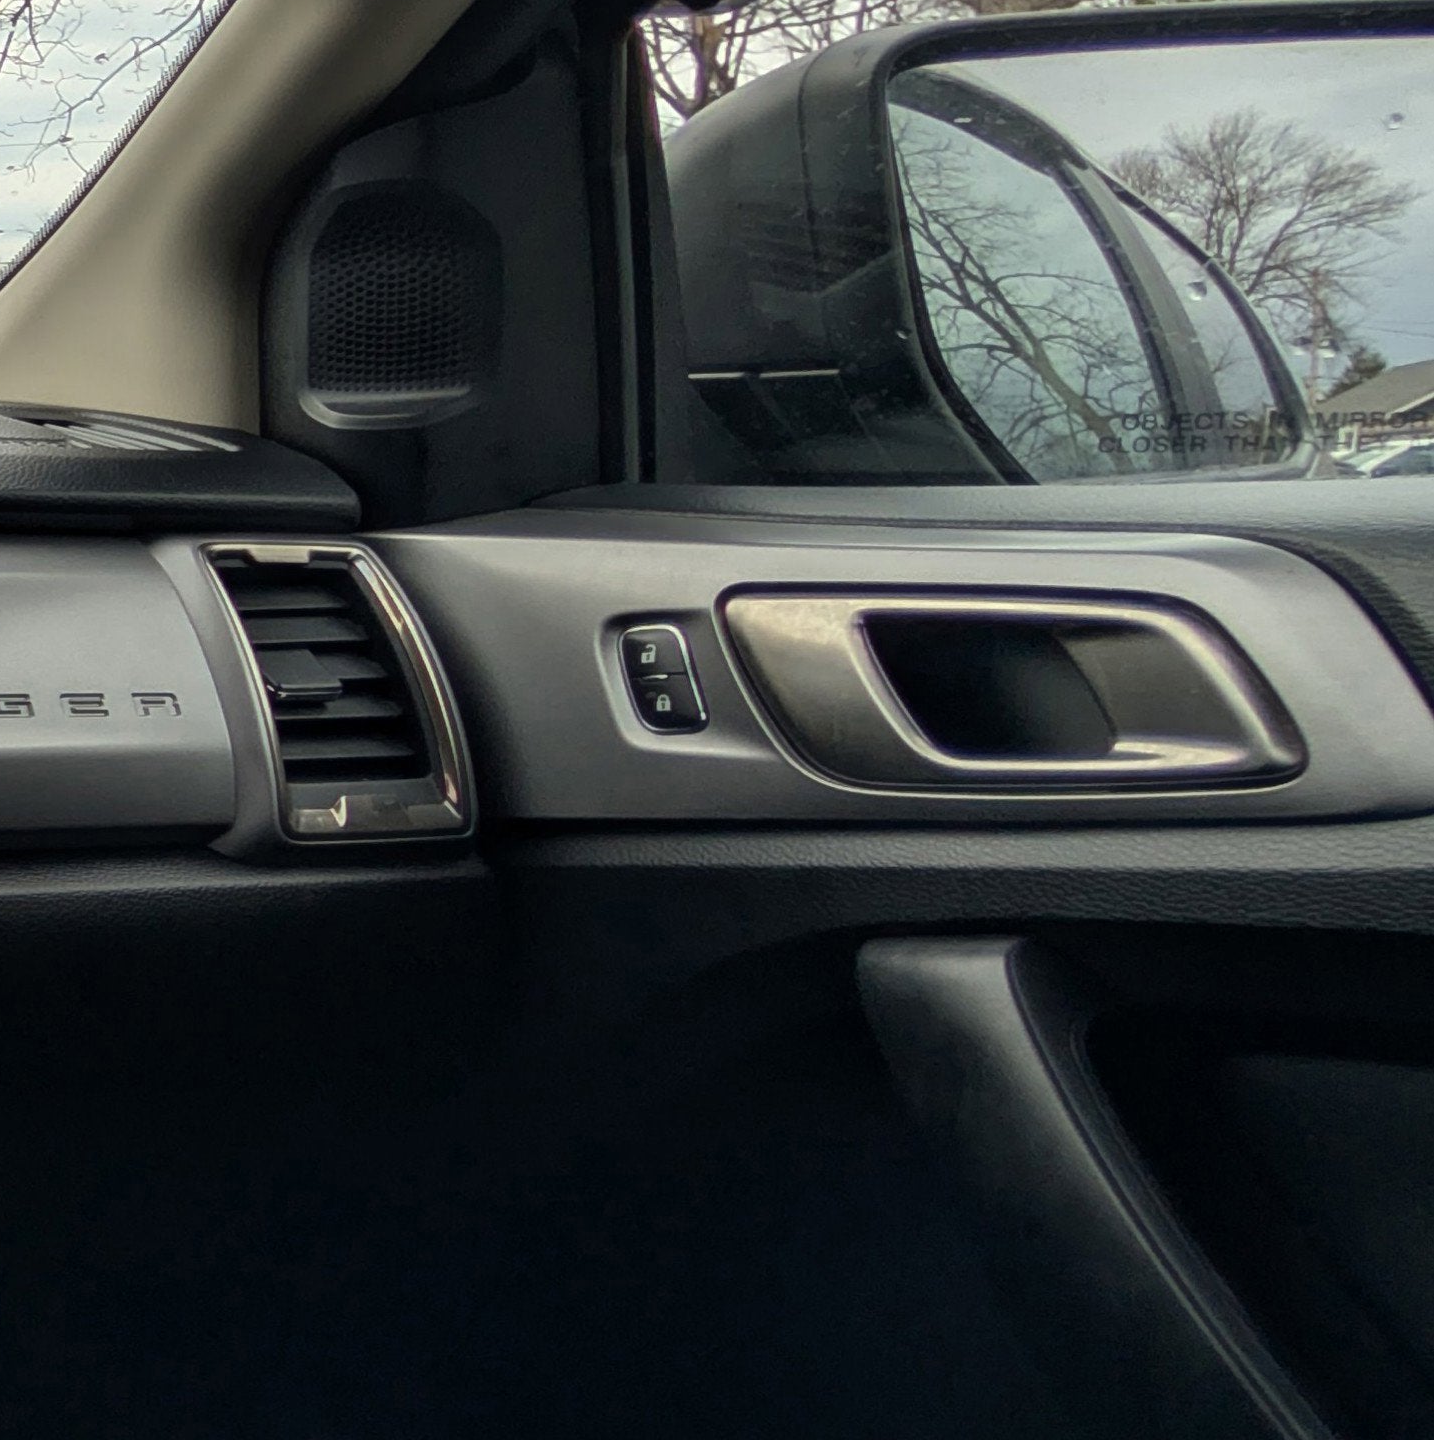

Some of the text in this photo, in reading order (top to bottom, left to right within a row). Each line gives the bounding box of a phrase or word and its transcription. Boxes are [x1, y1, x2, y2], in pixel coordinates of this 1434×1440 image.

[1121, 413, 1248, 430] OBJECTS
[1316, 411, 1428, 428] MIRROR
[1098, 436, 1208, 453] CLOSER
